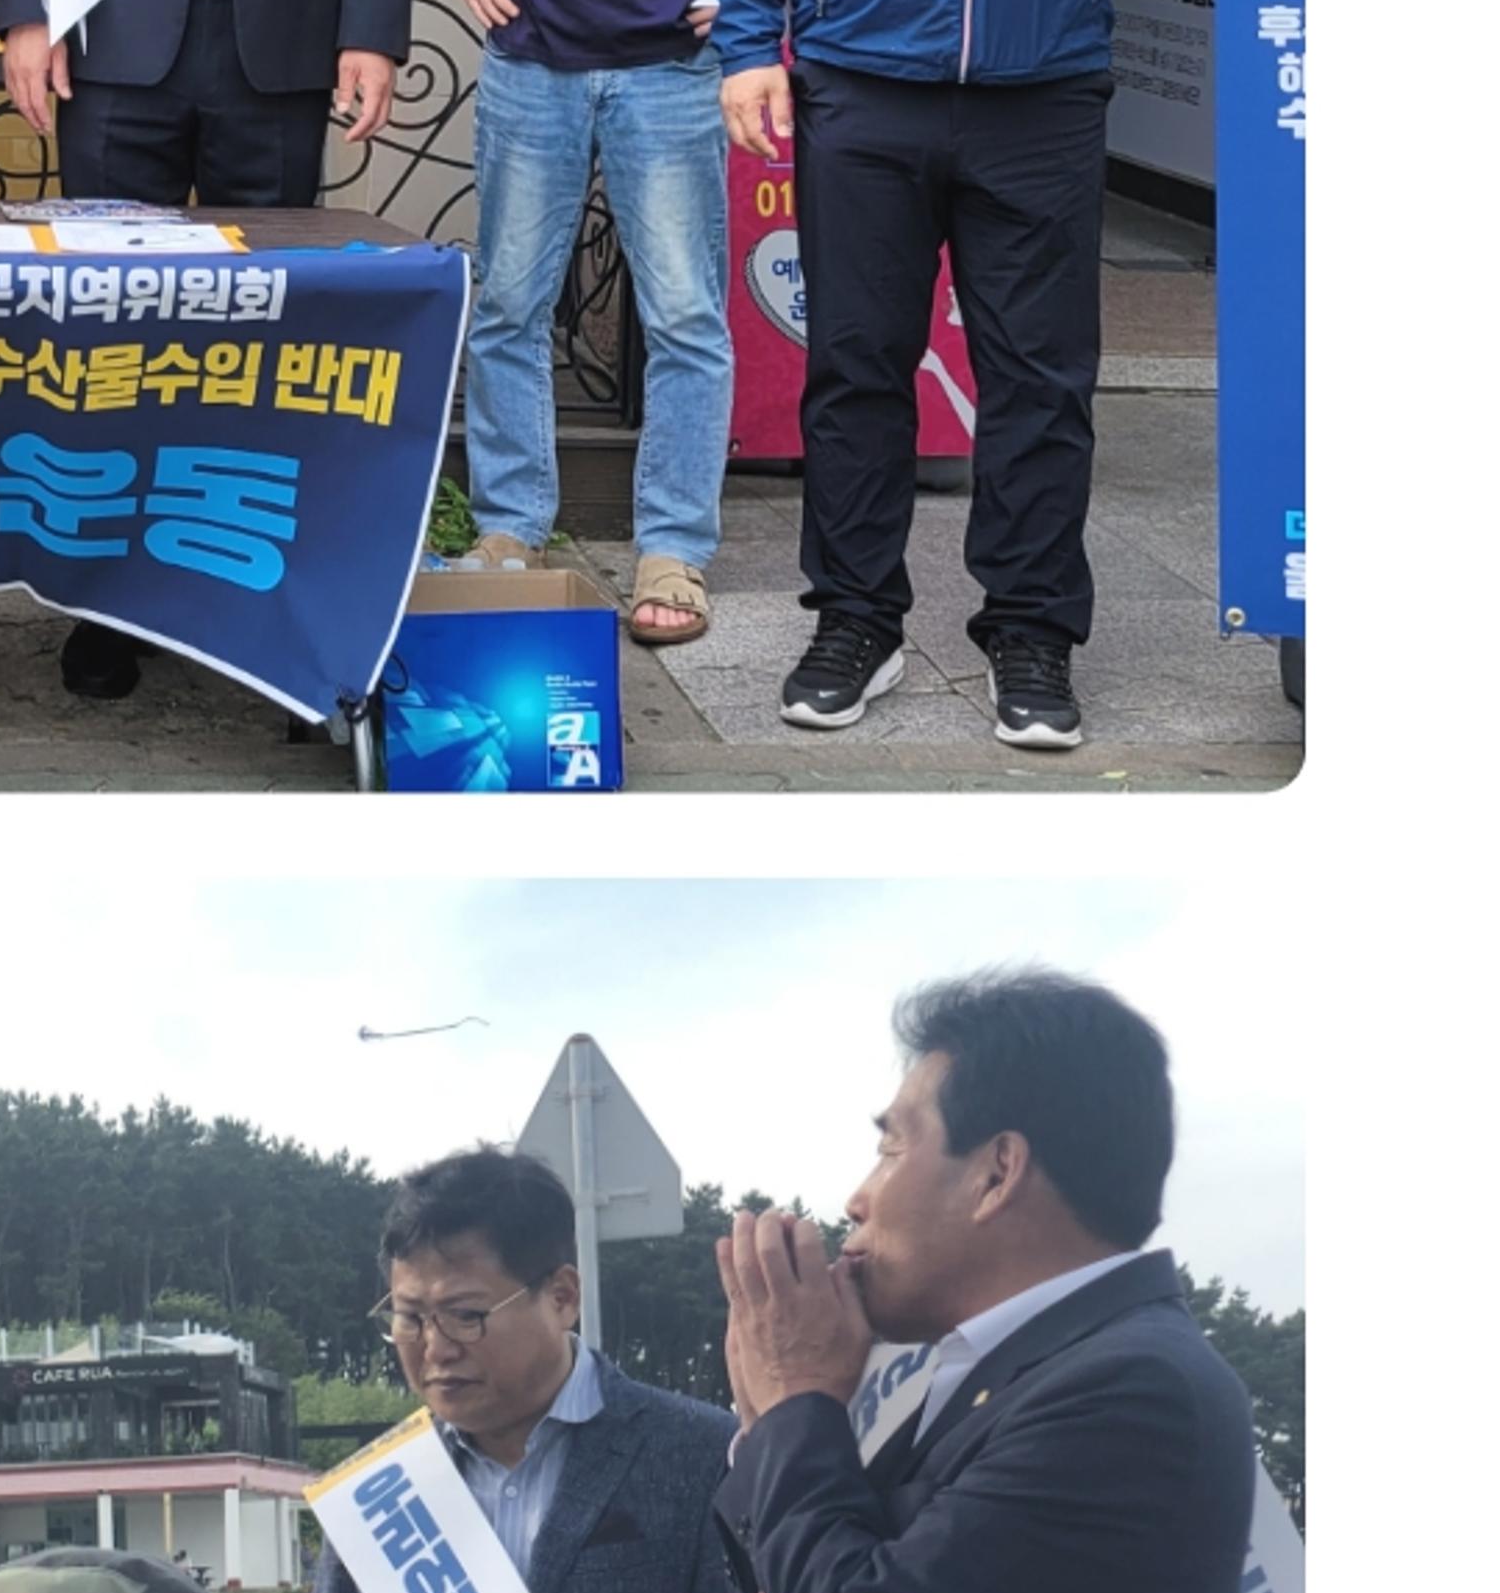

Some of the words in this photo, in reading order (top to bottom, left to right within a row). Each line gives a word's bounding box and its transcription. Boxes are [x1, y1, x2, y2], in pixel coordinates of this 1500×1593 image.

[276, 345, 401, 425] 반대
[32, 1366, 76, 1384] CAFE
[78, 1365, 113, 1383] RUA
